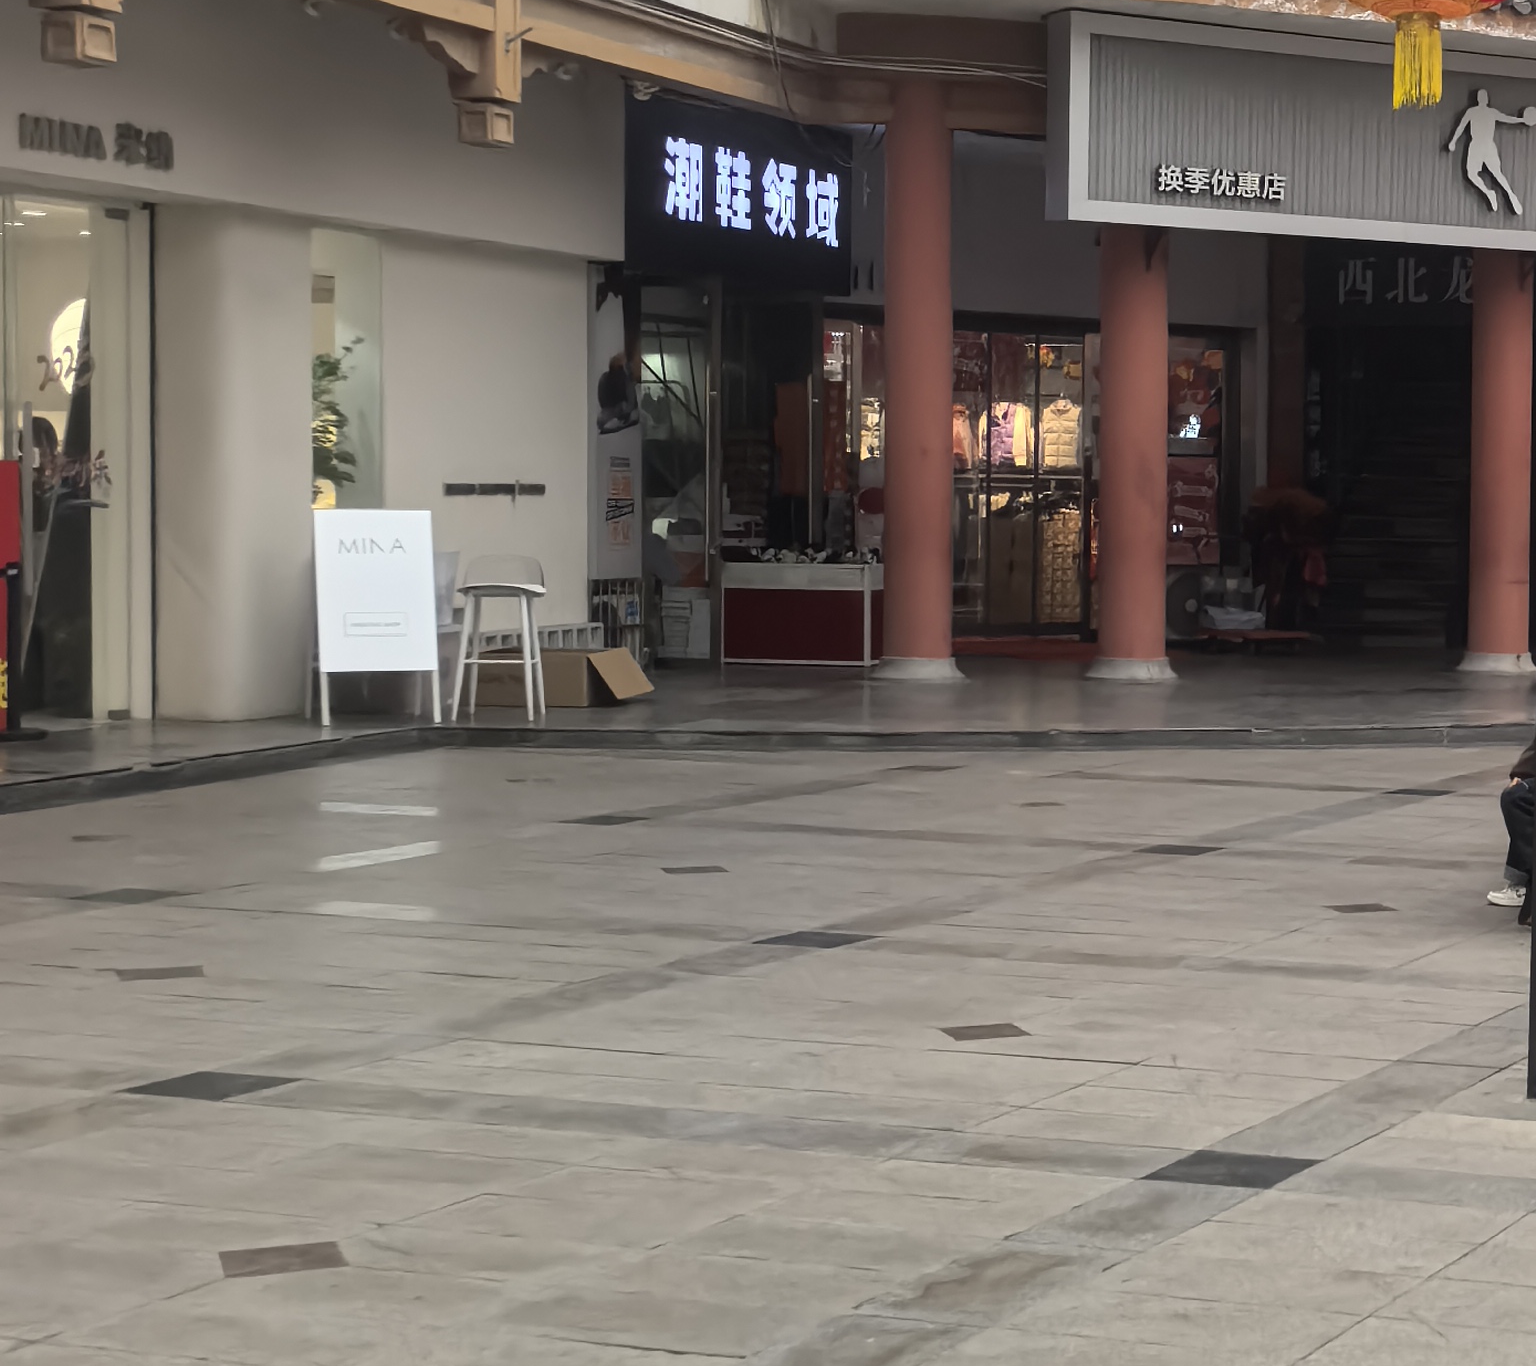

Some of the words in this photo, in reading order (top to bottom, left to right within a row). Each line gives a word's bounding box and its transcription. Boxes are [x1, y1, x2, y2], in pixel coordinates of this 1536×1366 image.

[18, 112, 107, 161] MINA
[664, 136, 839, 248] 潮鞋领域
[1158, 164, 1287, 201] 换季优惠店
[337, 537, 407, 555] MINA
